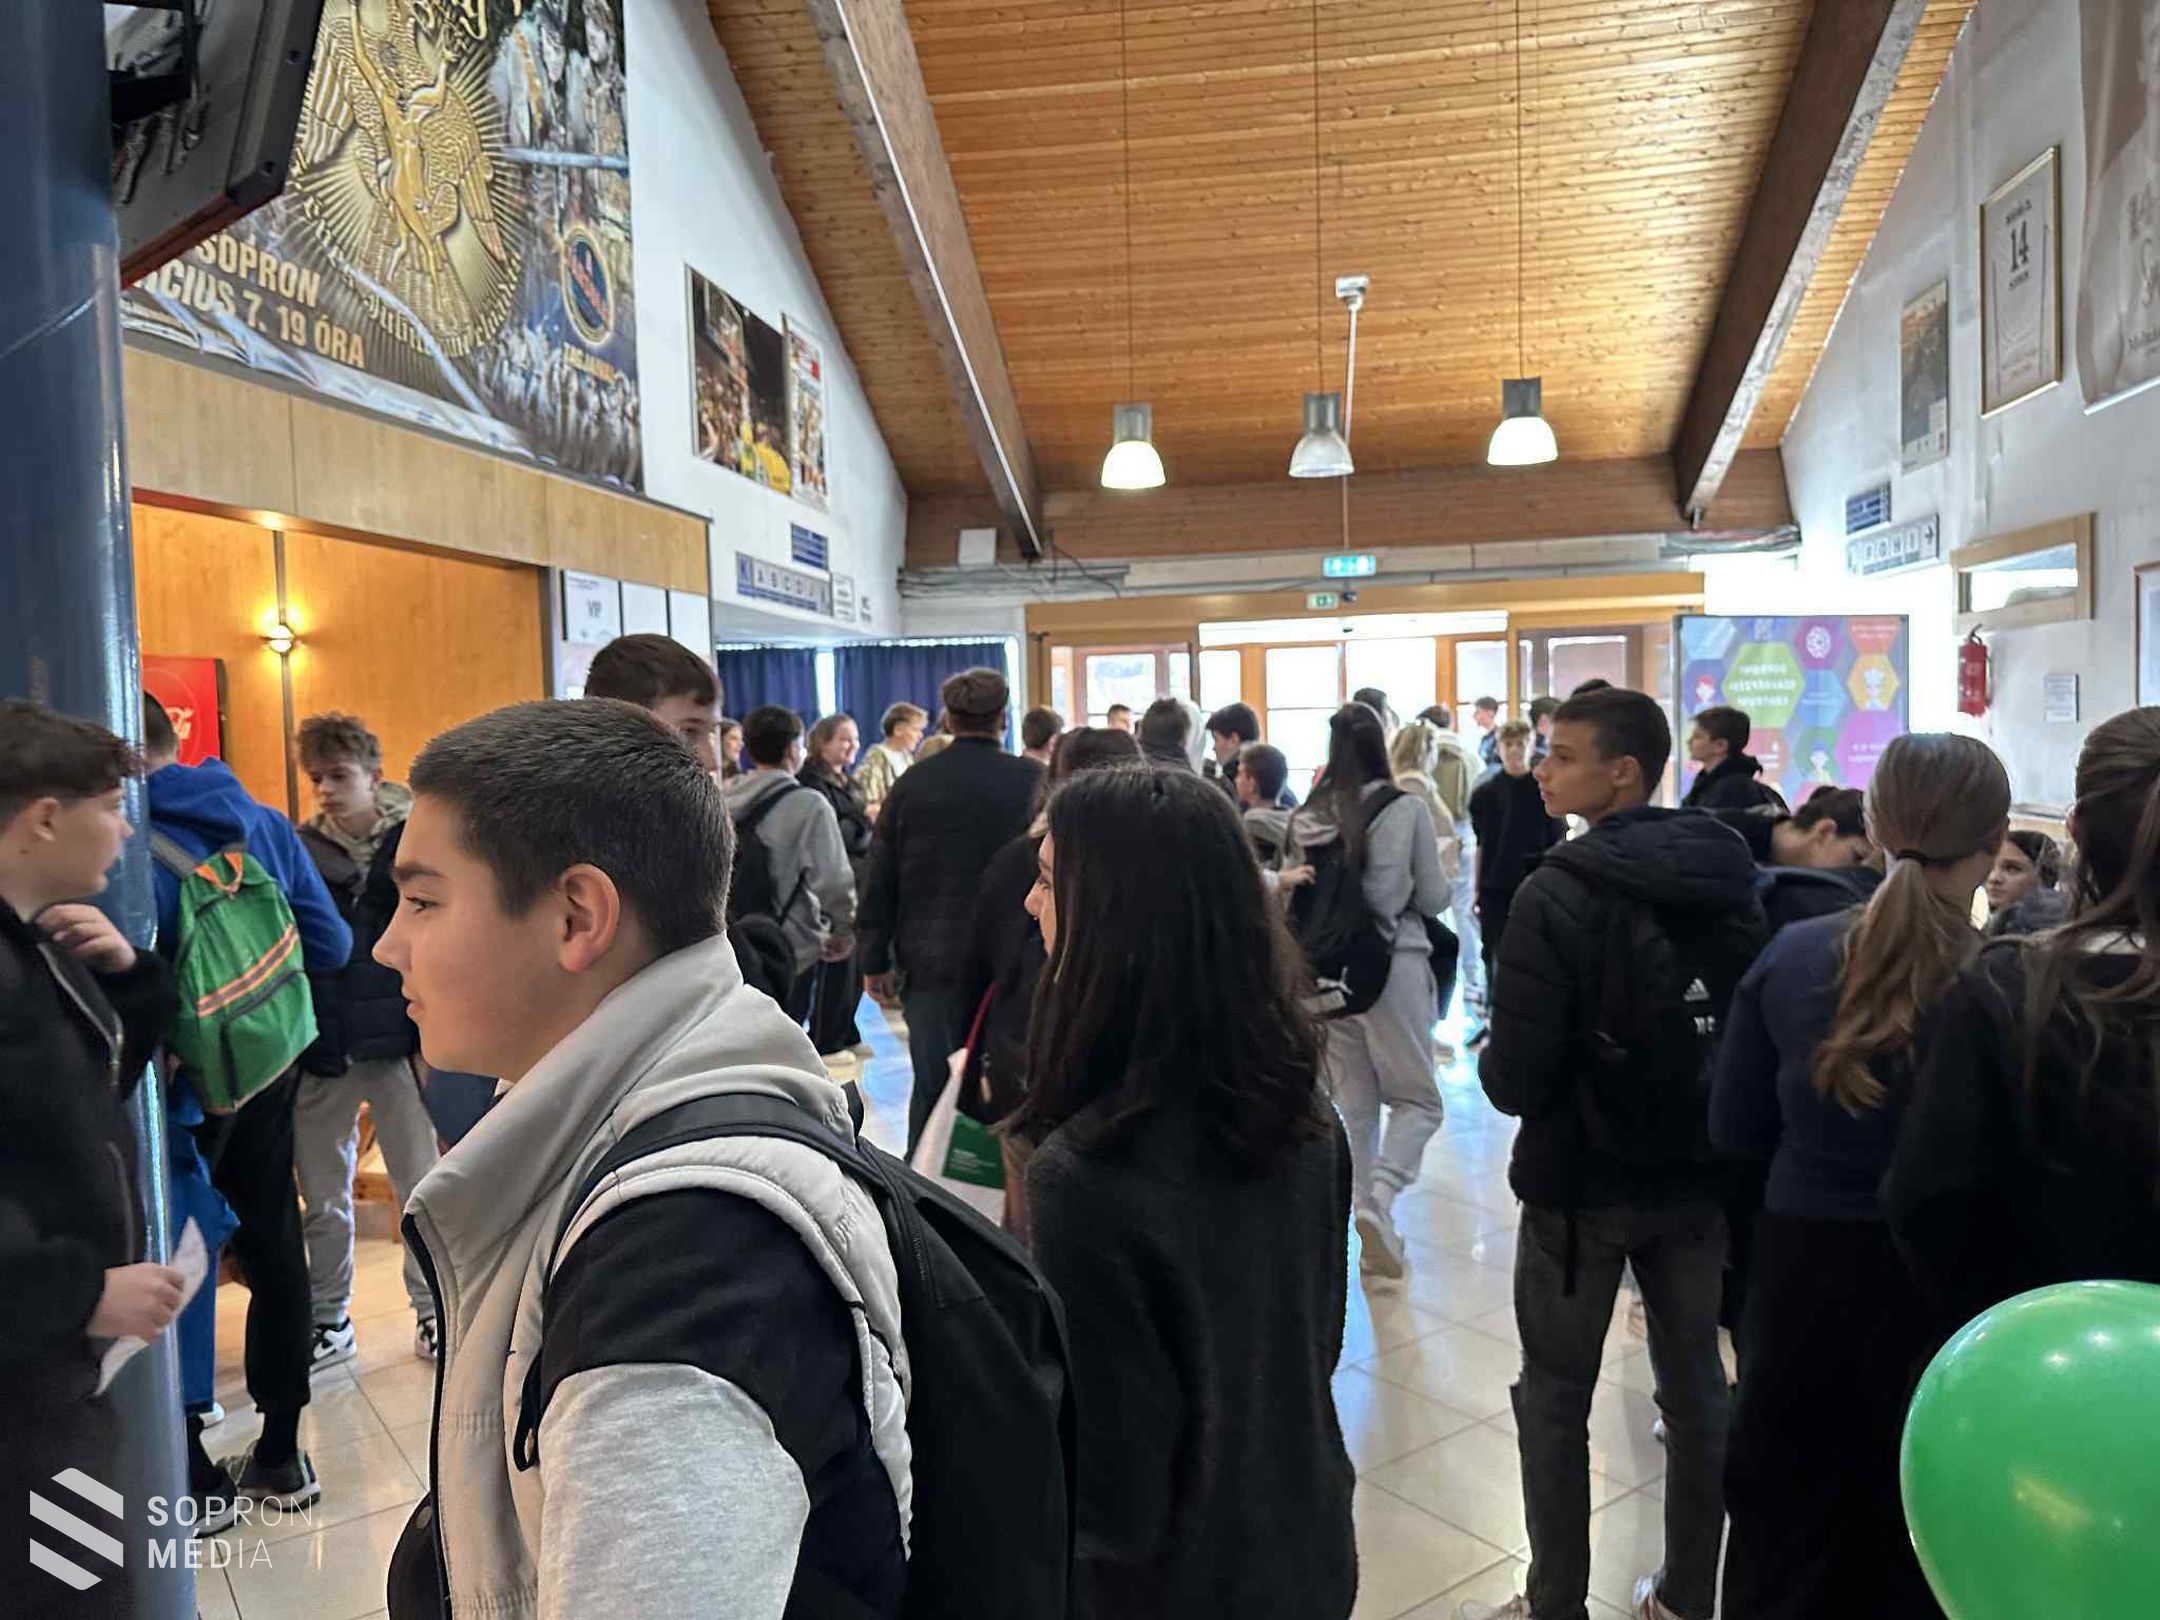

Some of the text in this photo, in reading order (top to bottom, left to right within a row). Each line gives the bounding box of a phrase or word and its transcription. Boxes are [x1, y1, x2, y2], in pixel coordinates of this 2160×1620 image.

[194, 233, 320, 308] SOPRON
[2010, 220, 2029, 273] 14
[276, 305, 306, 347] 19
[314, 314, 365, 369] ÓRA
